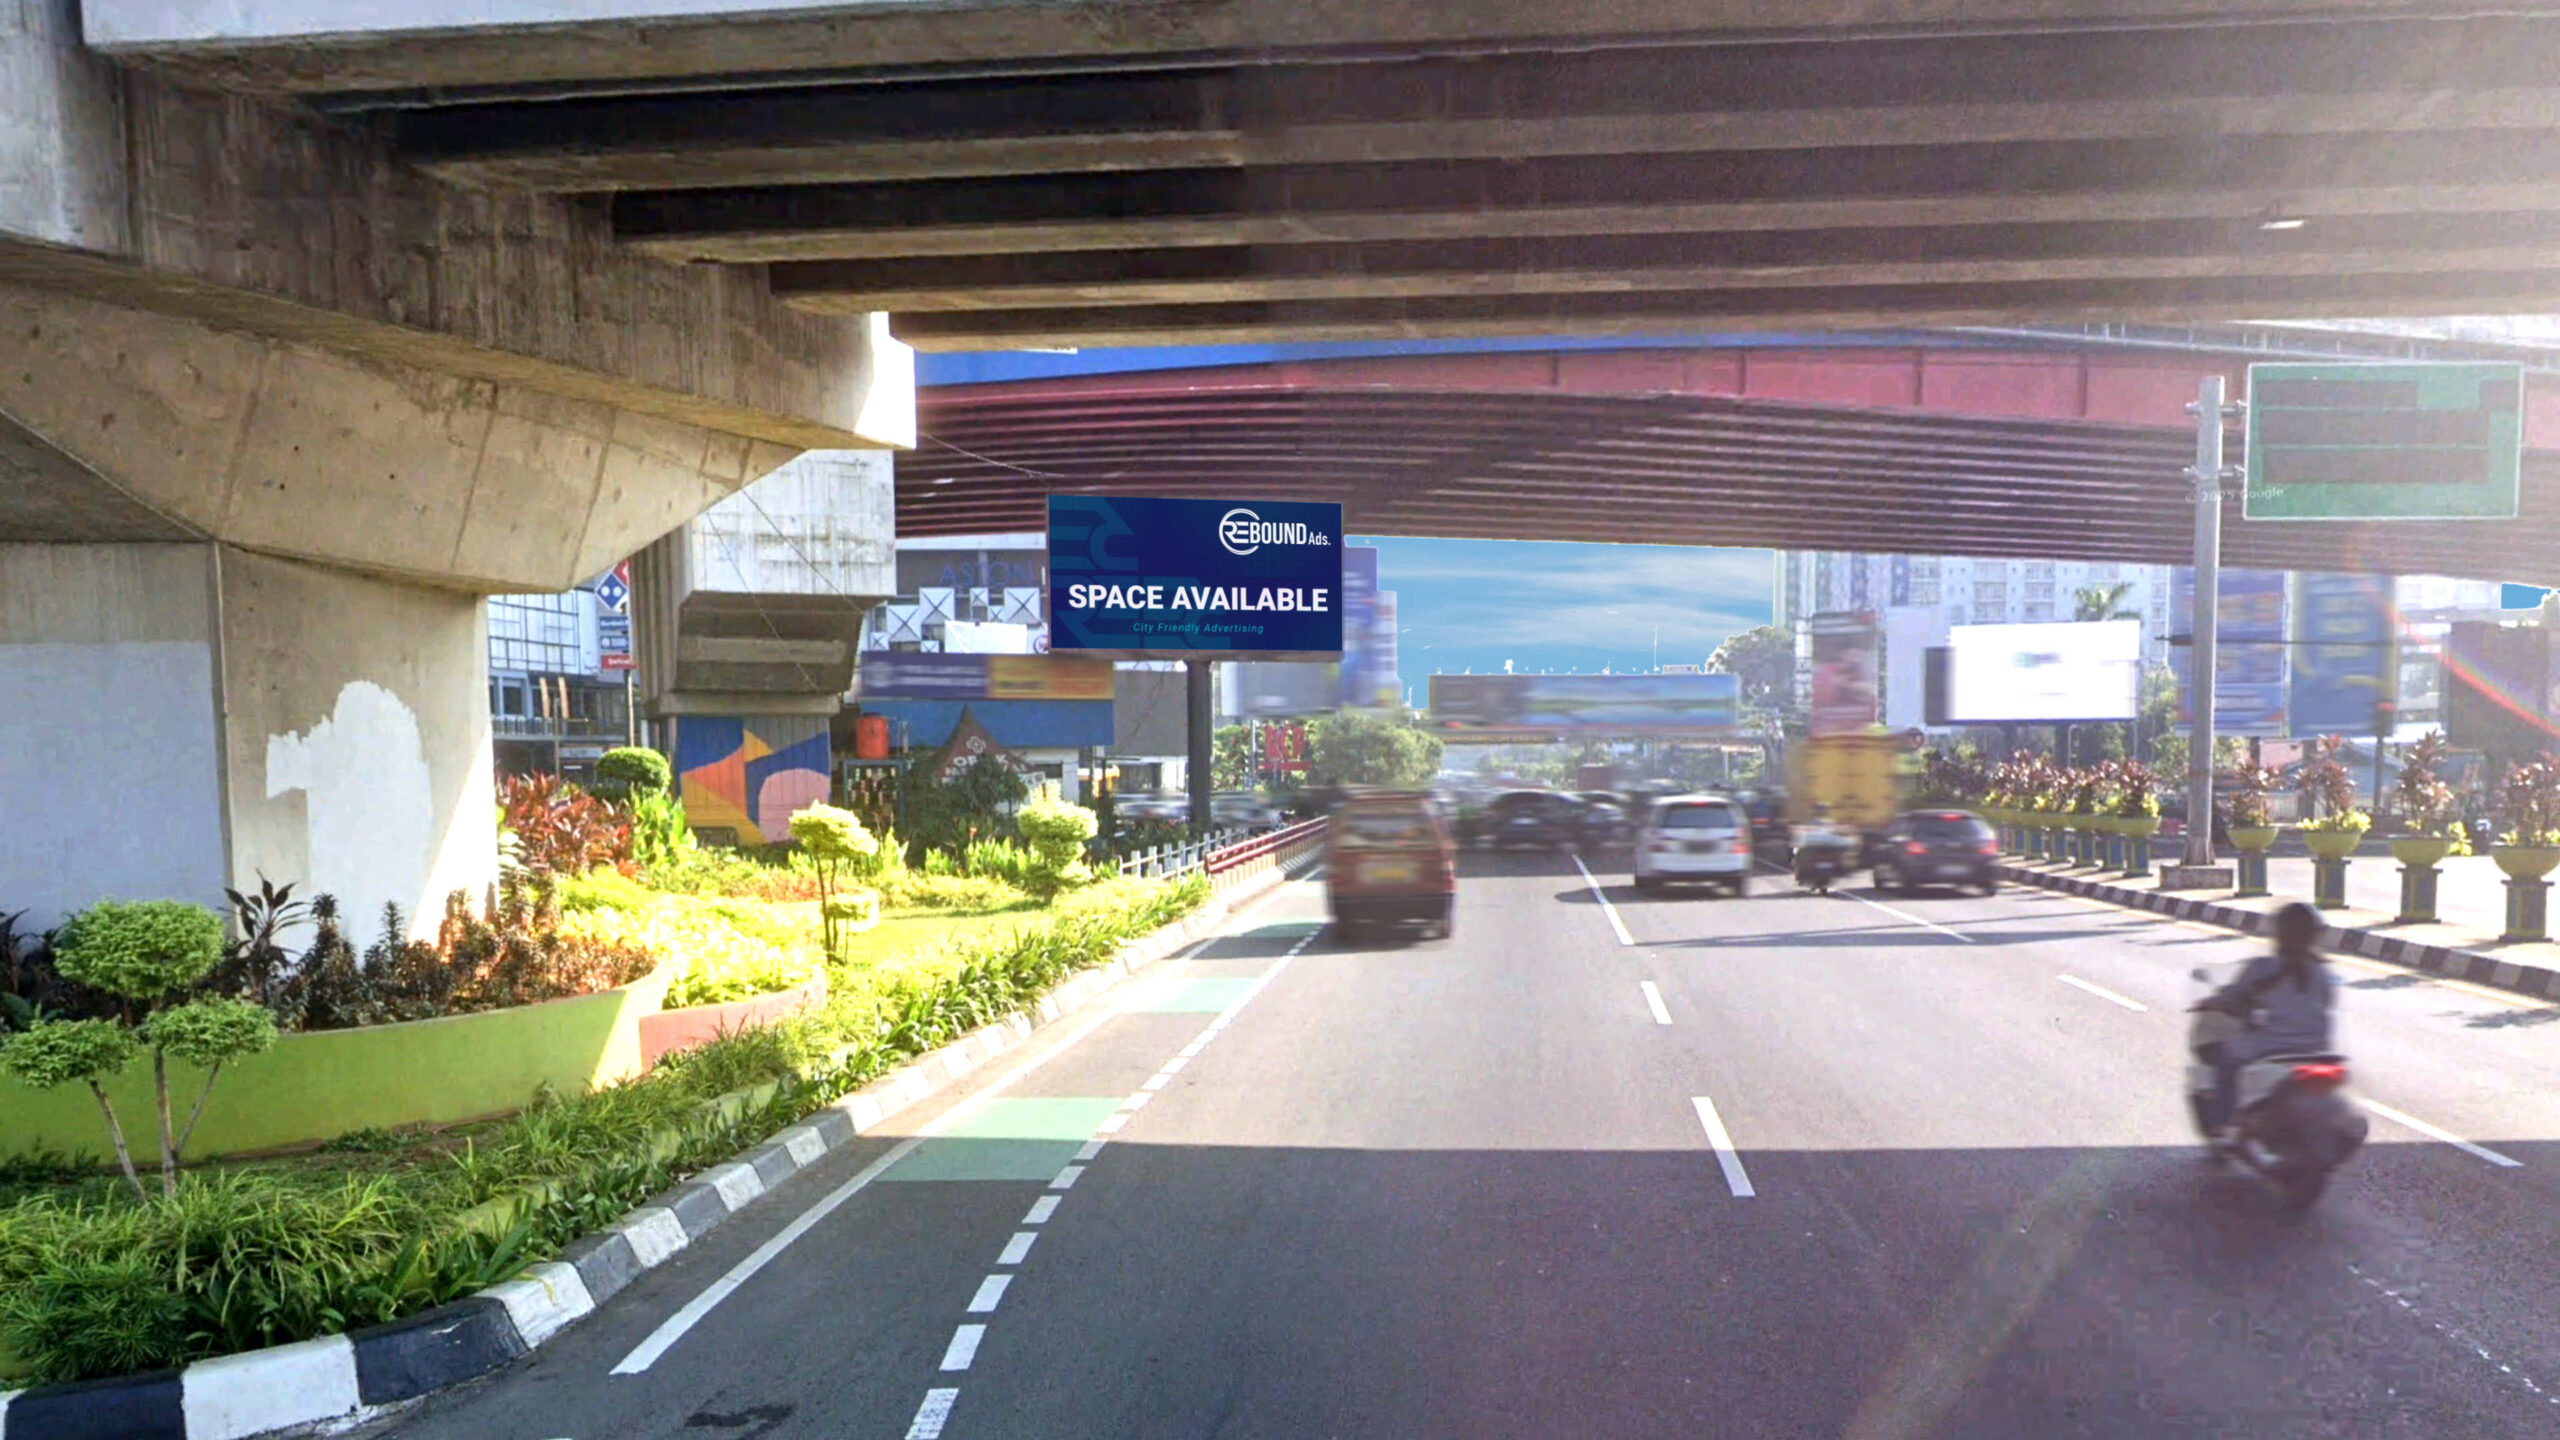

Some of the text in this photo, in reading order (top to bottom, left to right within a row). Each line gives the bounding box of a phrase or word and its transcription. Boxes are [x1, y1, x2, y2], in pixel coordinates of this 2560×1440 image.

[1219, 508, 1331, 555] REBOUND Ads.
[1068, 584, 1328, 612] SPACE AVAILABLE
[1133, 622, 1264, 635] City Friendly Advertising
